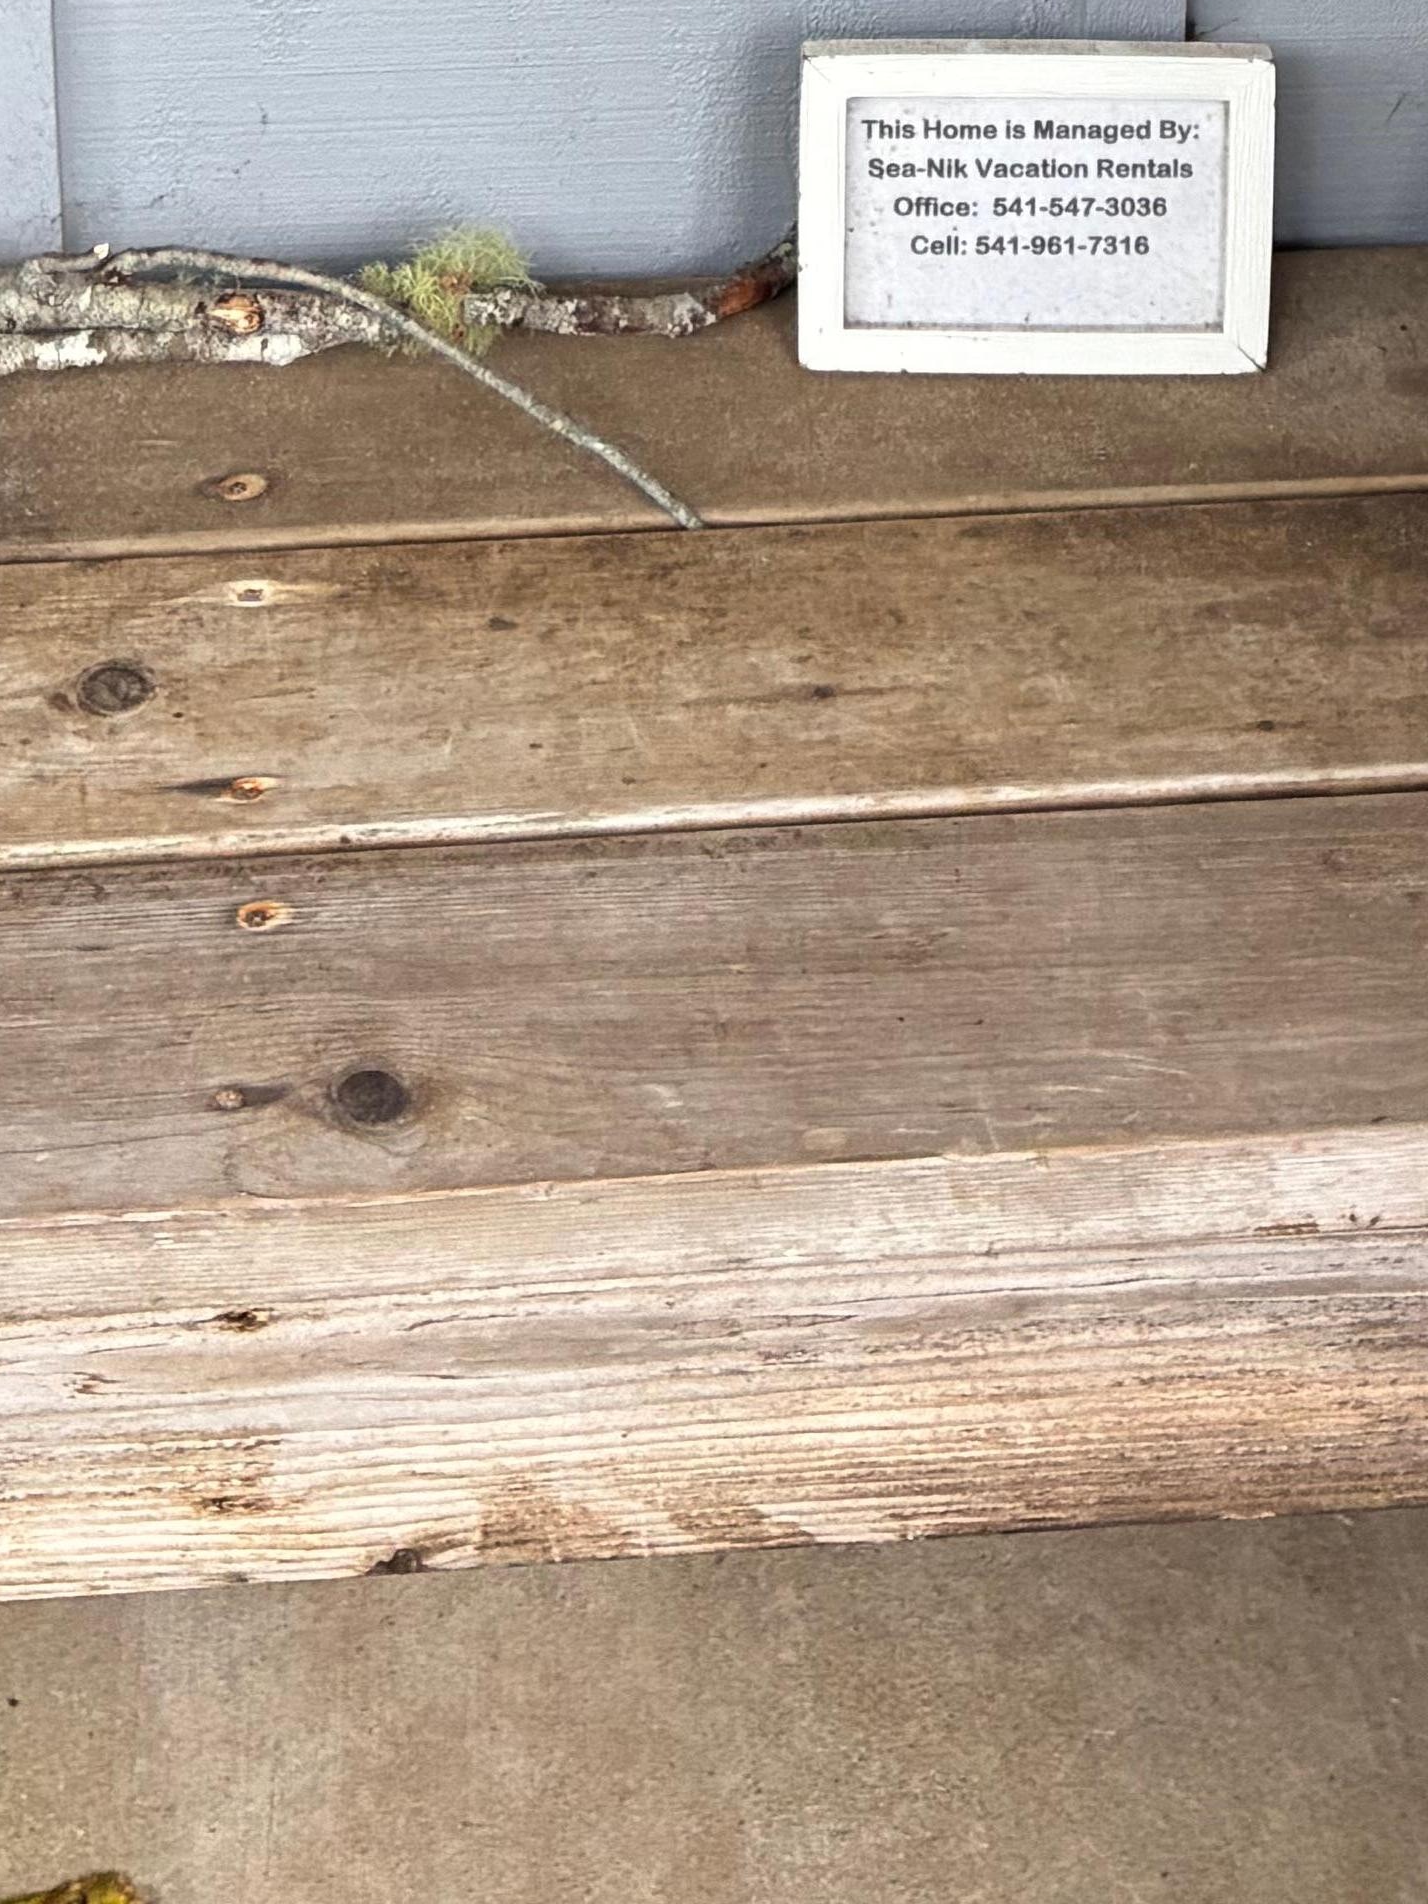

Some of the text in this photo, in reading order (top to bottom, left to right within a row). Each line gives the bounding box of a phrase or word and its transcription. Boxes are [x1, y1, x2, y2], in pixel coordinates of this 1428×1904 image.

[862, 119, 1200, 143] This Home is Managed By:
[868, 159, 1193, 179] Sea-Nik Vacation Rentals
[894, 196, 1167, 217] Office: 541-547-3036
[911, 235, 1150, 256] Cell: 541-961-7316
